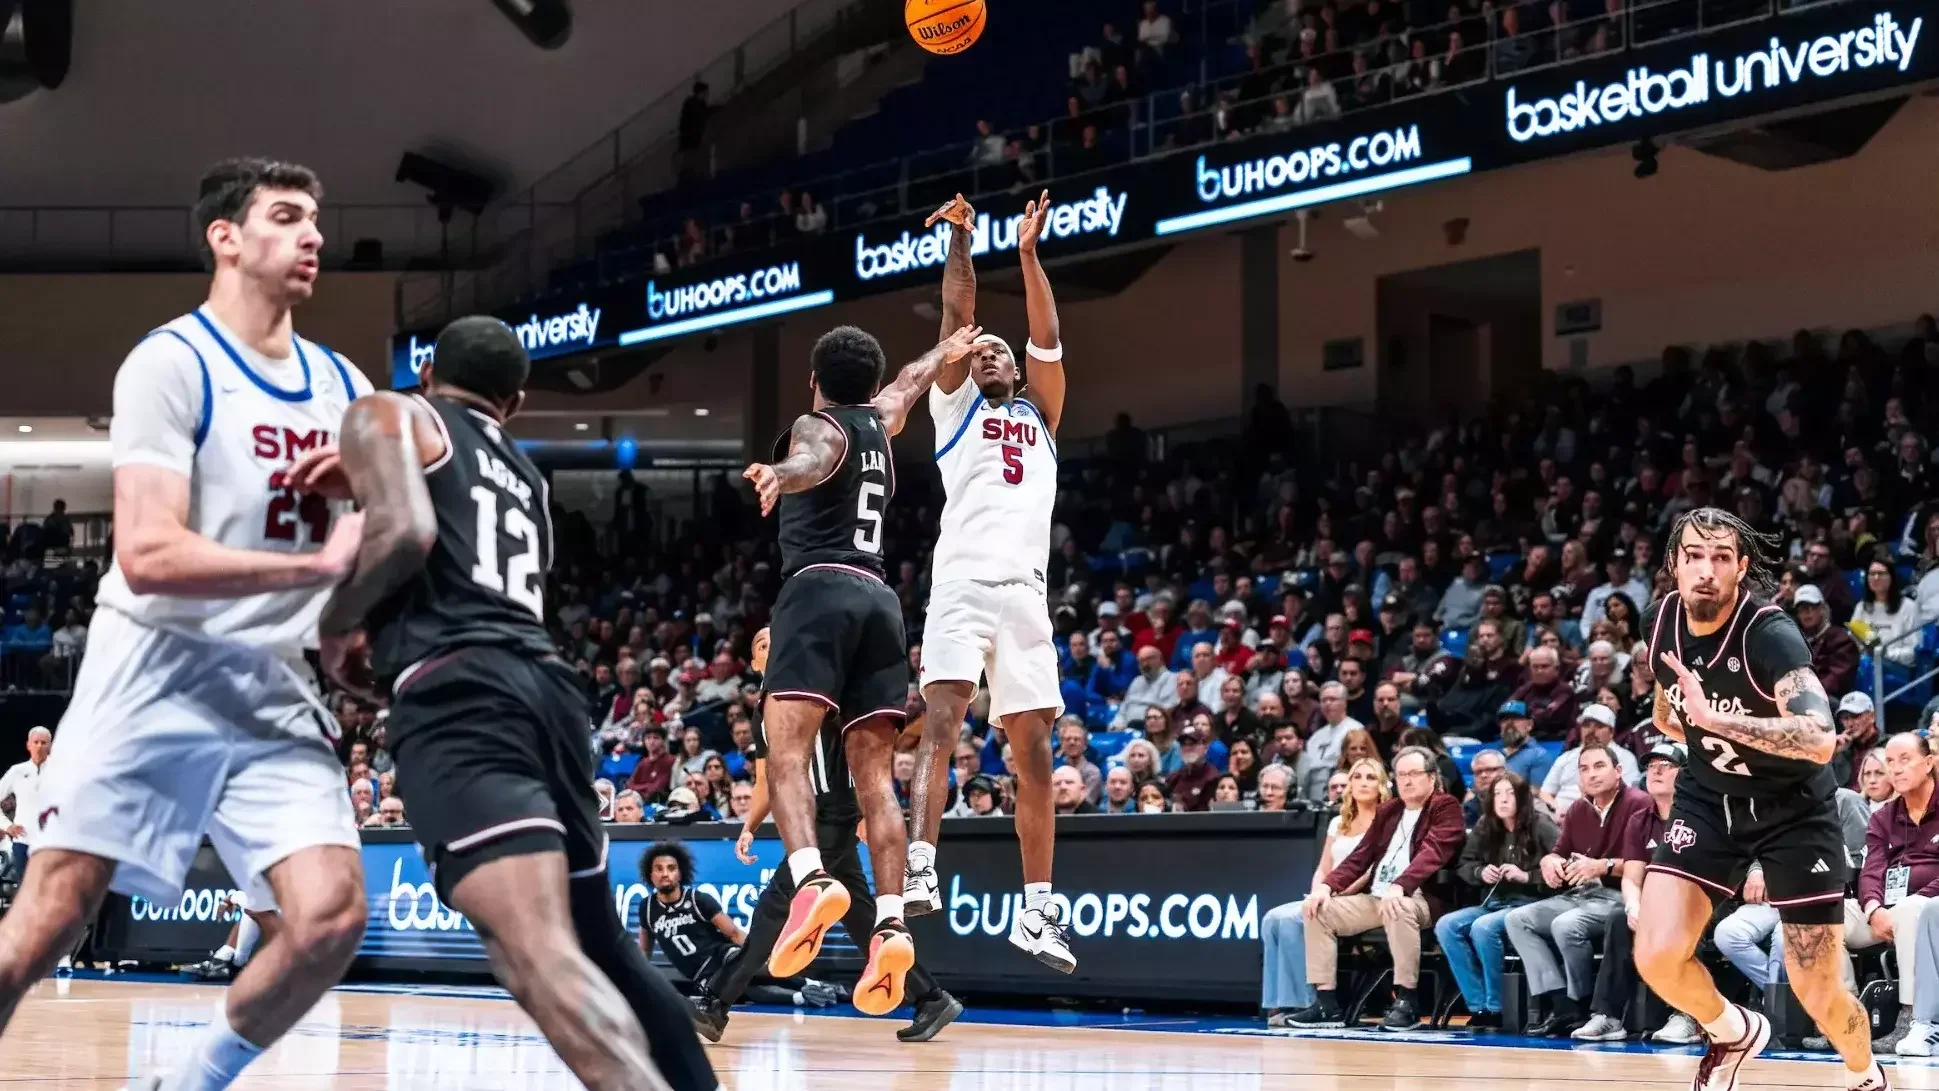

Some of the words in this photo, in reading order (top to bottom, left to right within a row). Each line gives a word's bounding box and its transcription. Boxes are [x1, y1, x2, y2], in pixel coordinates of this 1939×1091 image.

[917, 13, 970, 40] Wilson
[1506, 53, 1709, 143] basketball
[1715, 11, 1923, 97] university
[992, 186, 1128, 250] unersity
[503, 302, 601, 347] niversity
[251, 423, 332, 463] SM
[982, 417, 1038, 447] SMU
[1001, 443, 1024, 486] 5
[852, 480, 885, 554] 5
[469, 485, 545, 624] 12
[1663, 683, 1753, 727] Aies
[1700, 735, 1753, 777] 2
[653, 912, 697, 939] Aggies
[671, 934, 697, 957] 0
